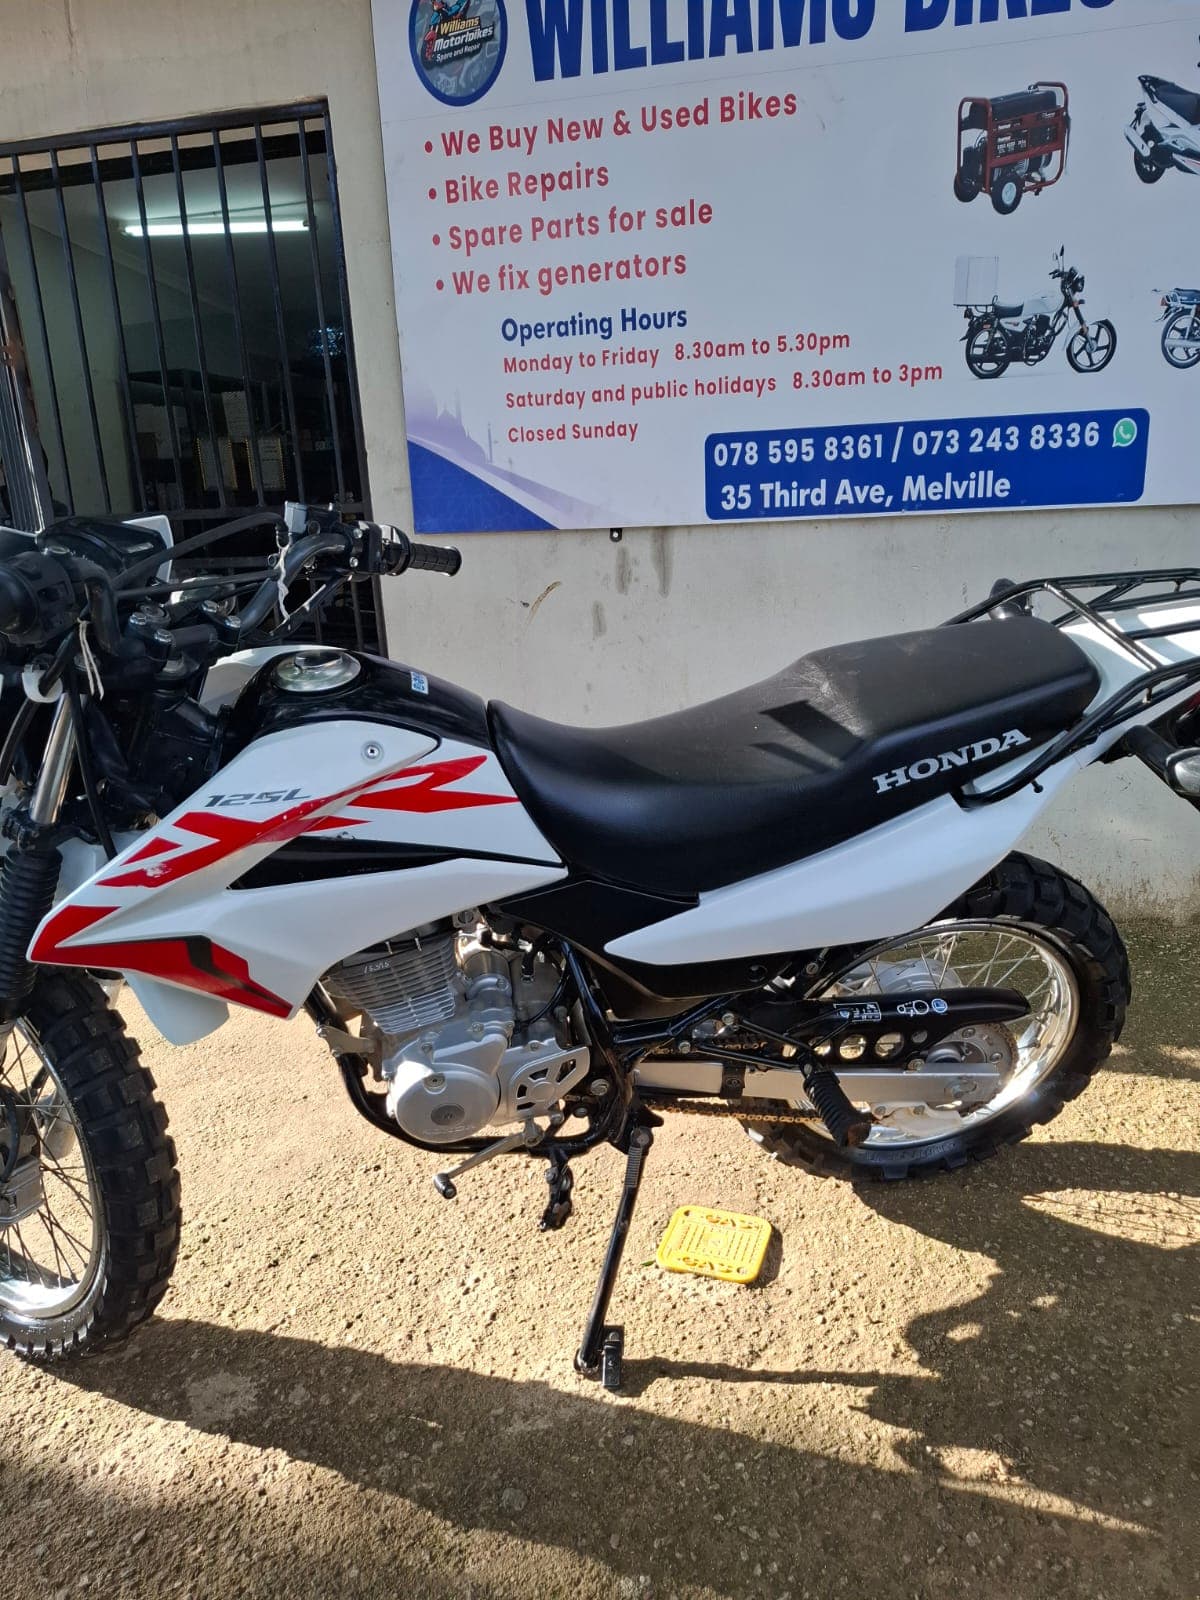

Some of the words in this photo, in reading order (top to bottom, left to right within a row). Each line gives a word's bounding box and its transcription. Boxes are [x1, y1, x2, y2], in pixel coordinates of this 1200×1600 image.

[440, 17, 480, 35] Williams
[436, 52, 453, 62] Spare
[453, 47, 464, 57] and
[464, 43, 481, 54] Repair
[440, 131, 481, 157] We
[489, 125, 538, 155] Buy
[547, 118, 603, 145] New
[612, 110, 630, 136] &
[640, 98, 709, 133] Used
[719, 91, 797, 124] Bikes
[444, 175, 499, 205] Bike
[507, 162, 609, 201] Repairs
[448, 224, 522, 257] Spare
[531, 214, 599, 241] Parts
[609, 207, 645, 233] for
[655, 199, 712, 229] sale
[452, 271, 490, 295] We
[498, 266, 529, 290] fix
[537, 255, 686, 296] generators
[501, 312, 613, 346] Operating
[620, 308, 688, 332] Hours
[503, 355, 572, 372] Monday
[578, 353, 596, 367] to
[601, 348, 658, 368] Friday
[675, 341, 745, 360] 8.30am
[751, 339, 770, 355] to
[777, 333, 850, 354] 5.30pm
[505, 390, 585, 409] Saturday
[591, 385, 625, 403] and
[630, 383, 687, 405] public
[693, 377, 776, 397] holidays
[792, 369, 865, 390] 8.30am
[872, 368, 892, 384] to
[900, 364, 943, 385] 3pm
[508, 425, 567, 443] Closed
[572, 422, 637, 441] Sunday
[713, 441, 759, 467] 078
[767, 438, 814, 464] 595
[824, 433, 884, 461] 8361
[890, 426, 904, 463] /
[912, 430, 960, 456] 073
[969, 426, 1019, 453] 243
[1030, 421, 1099, 450] 8336
[721, 484, 752, 510] 35
[759, 480, 827, 508] Third
[834, 478, 893, 507] Ave,
[902, 470, 1011, 503] Melville
[872, 728, 1031, 794] HONDA
[205, 788, 312, 808] 125L
